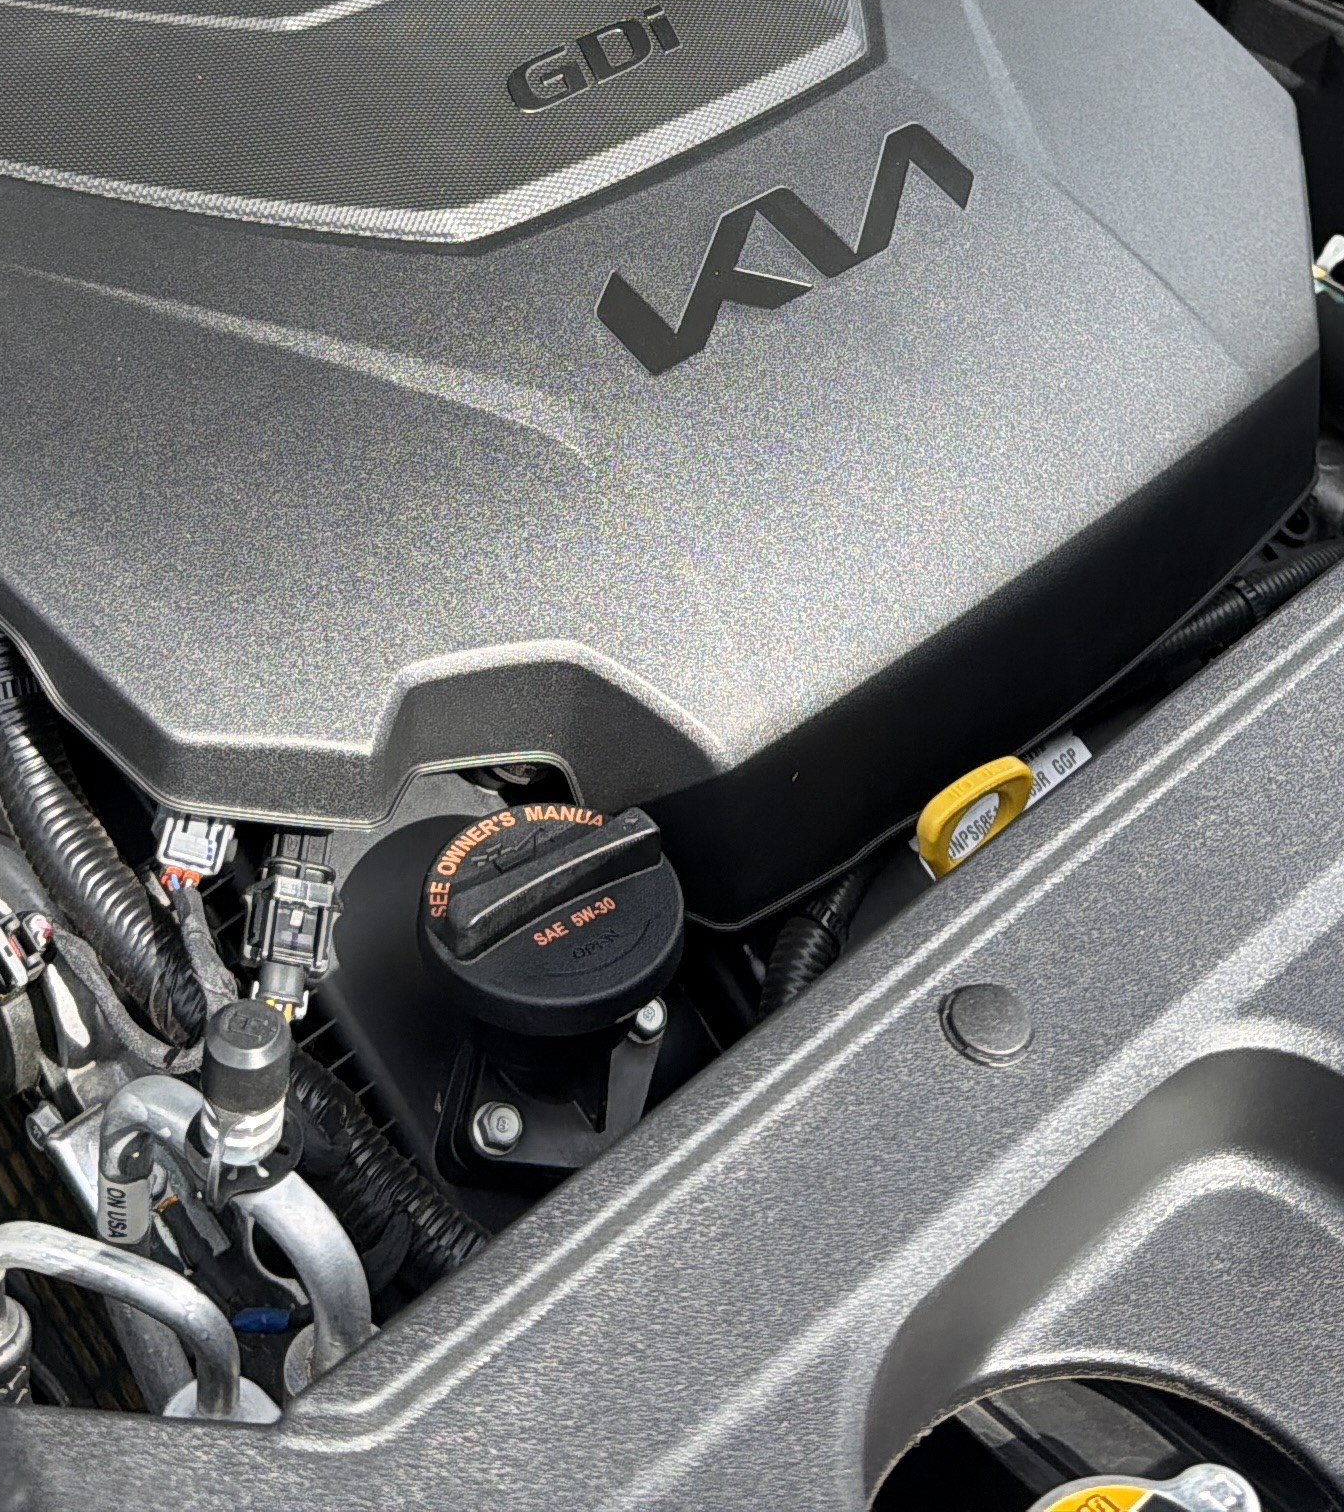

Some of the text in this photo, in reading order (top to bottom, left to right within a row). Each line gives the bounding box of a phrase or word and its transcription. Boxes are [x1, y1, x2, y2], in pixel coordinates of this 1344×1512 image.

[507, 5, 682, 114] GDi
[596, 122, 974, 376] KIA
[1051, 747, 1078, 775] GGP
[430, 805, 604, 918] SEE OWNER'S MANUA
[533, 896, 617, 947] SAE 5W-30
[106, 1187, 128, 1238] ON USA
